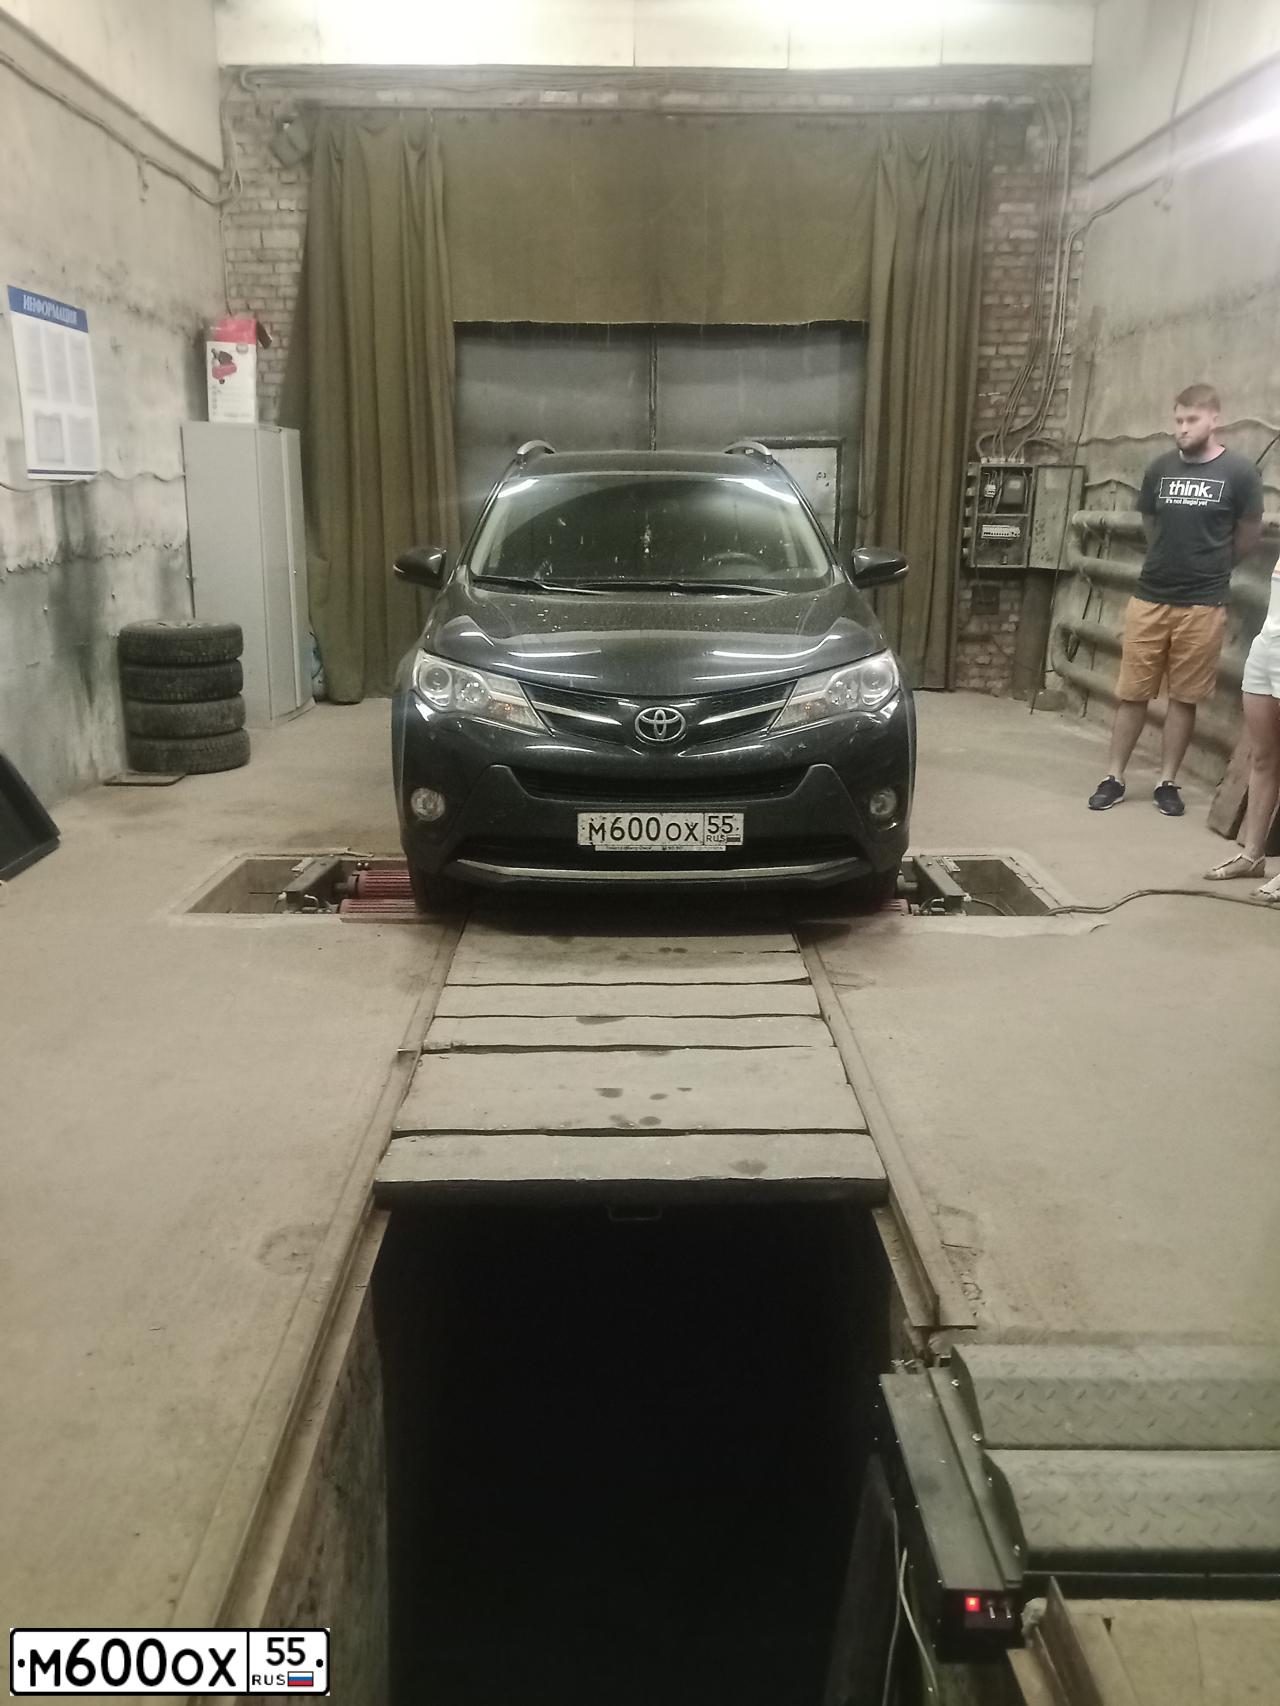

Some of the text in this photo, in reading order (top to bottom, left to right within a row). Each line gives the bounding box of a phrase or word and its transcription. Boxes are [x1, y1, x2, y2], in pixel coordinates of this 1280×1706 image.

[1169, 480, 1213, 498] think.
[707, 815, 734, 834] 55
[706, 834, 726, 843] RUS
